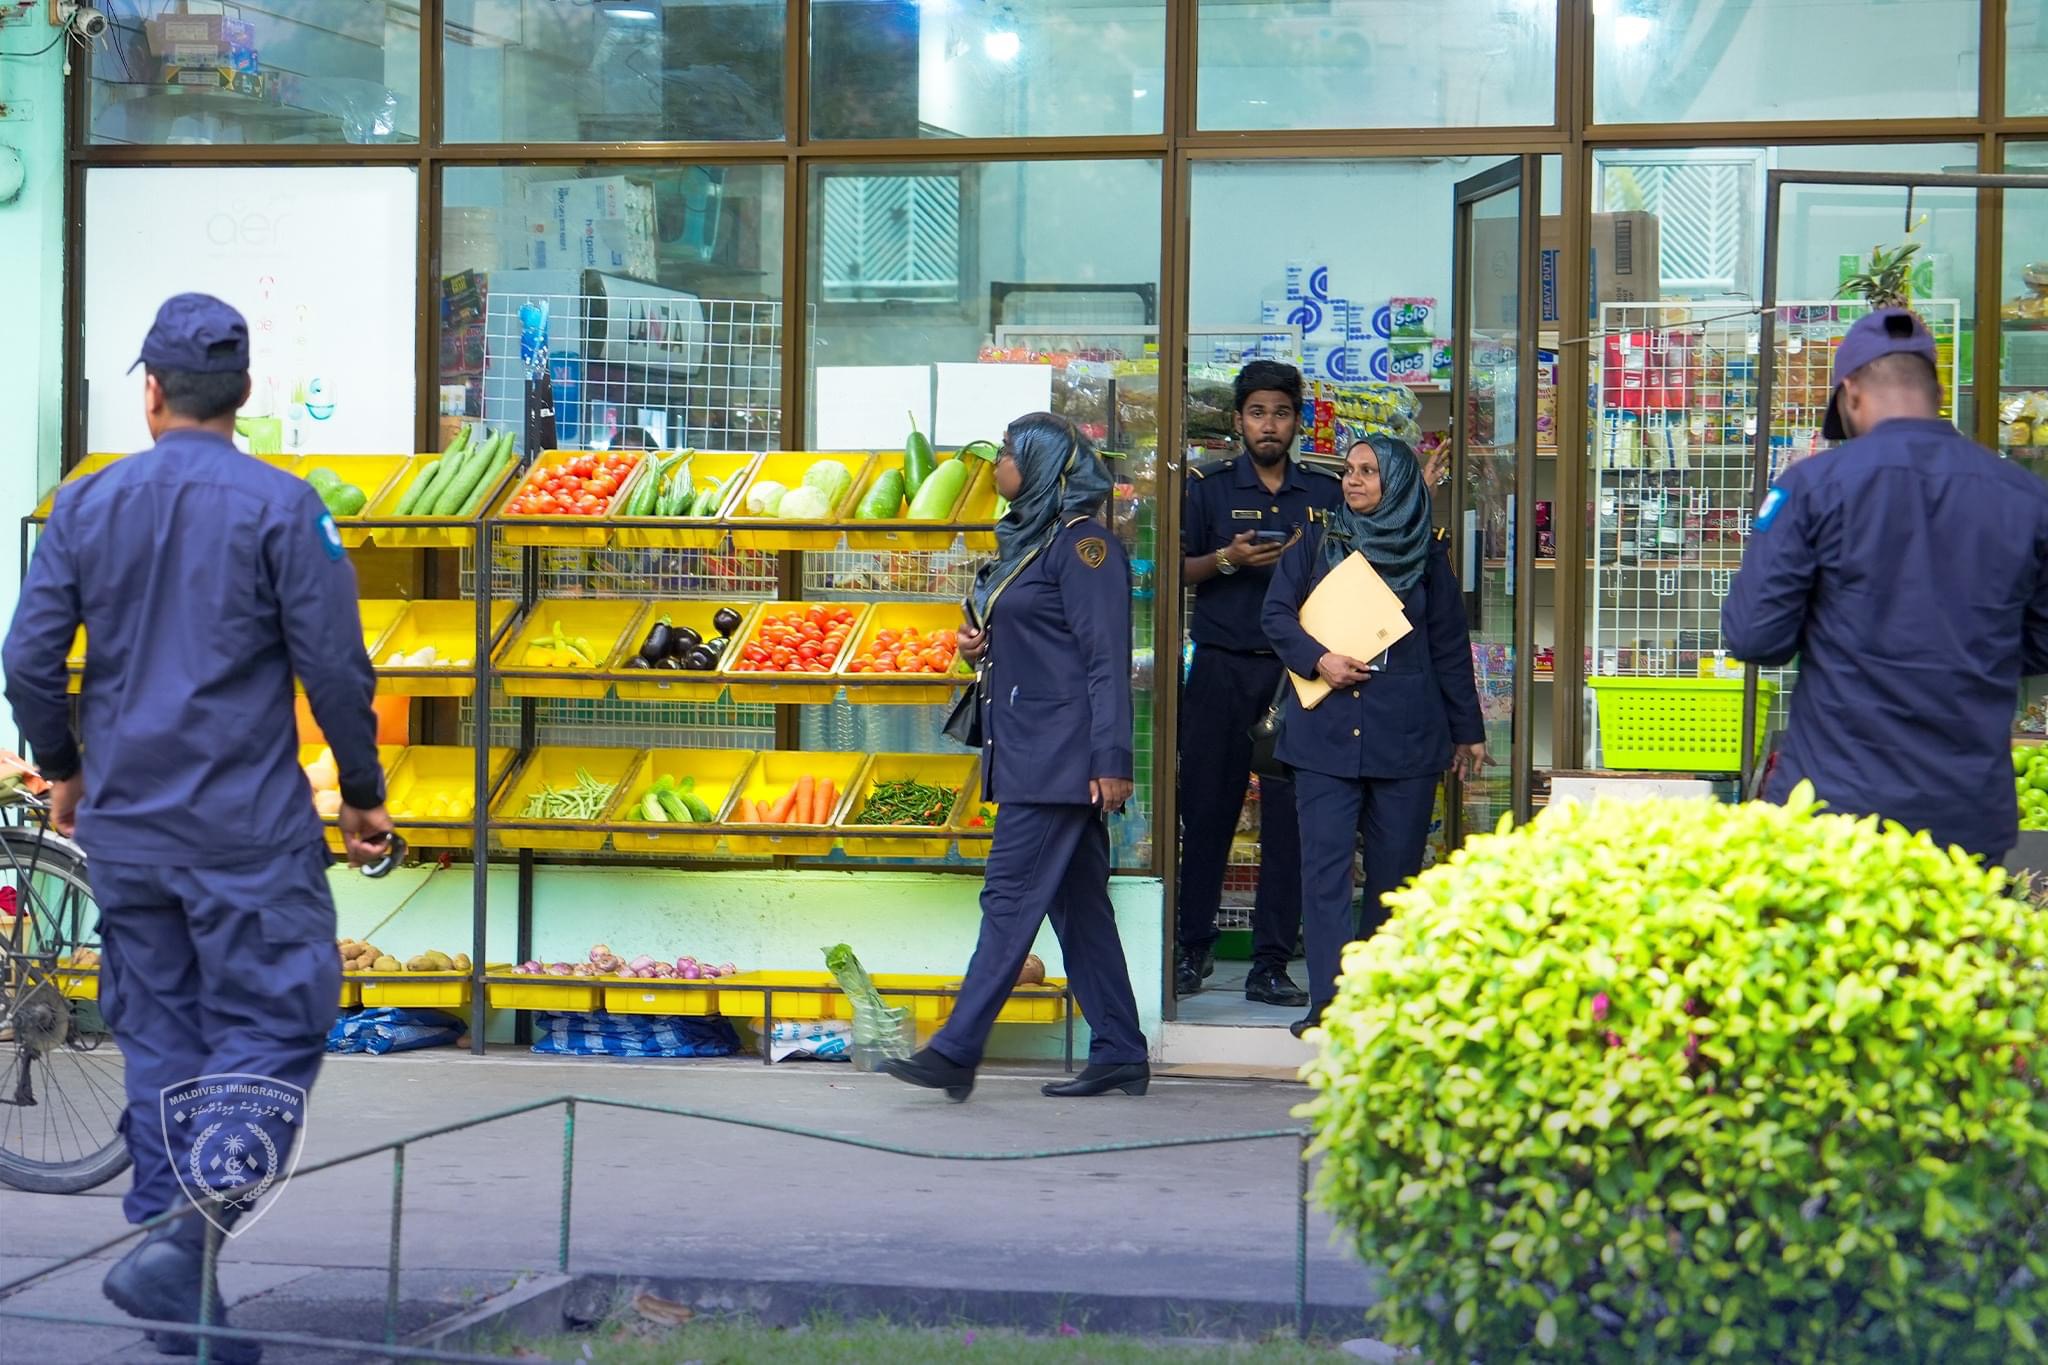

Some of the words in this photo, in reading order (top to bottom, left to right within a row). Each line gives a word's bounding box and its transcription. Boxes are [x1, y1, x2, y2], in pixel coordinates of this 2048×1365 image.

[1543, 253, 1552, 281] DUTY
[1543, 284, 1552, 319] HEAVY
[1394, 306, 1428, 325] Solo
[1432, 350, 1452, 368] So
